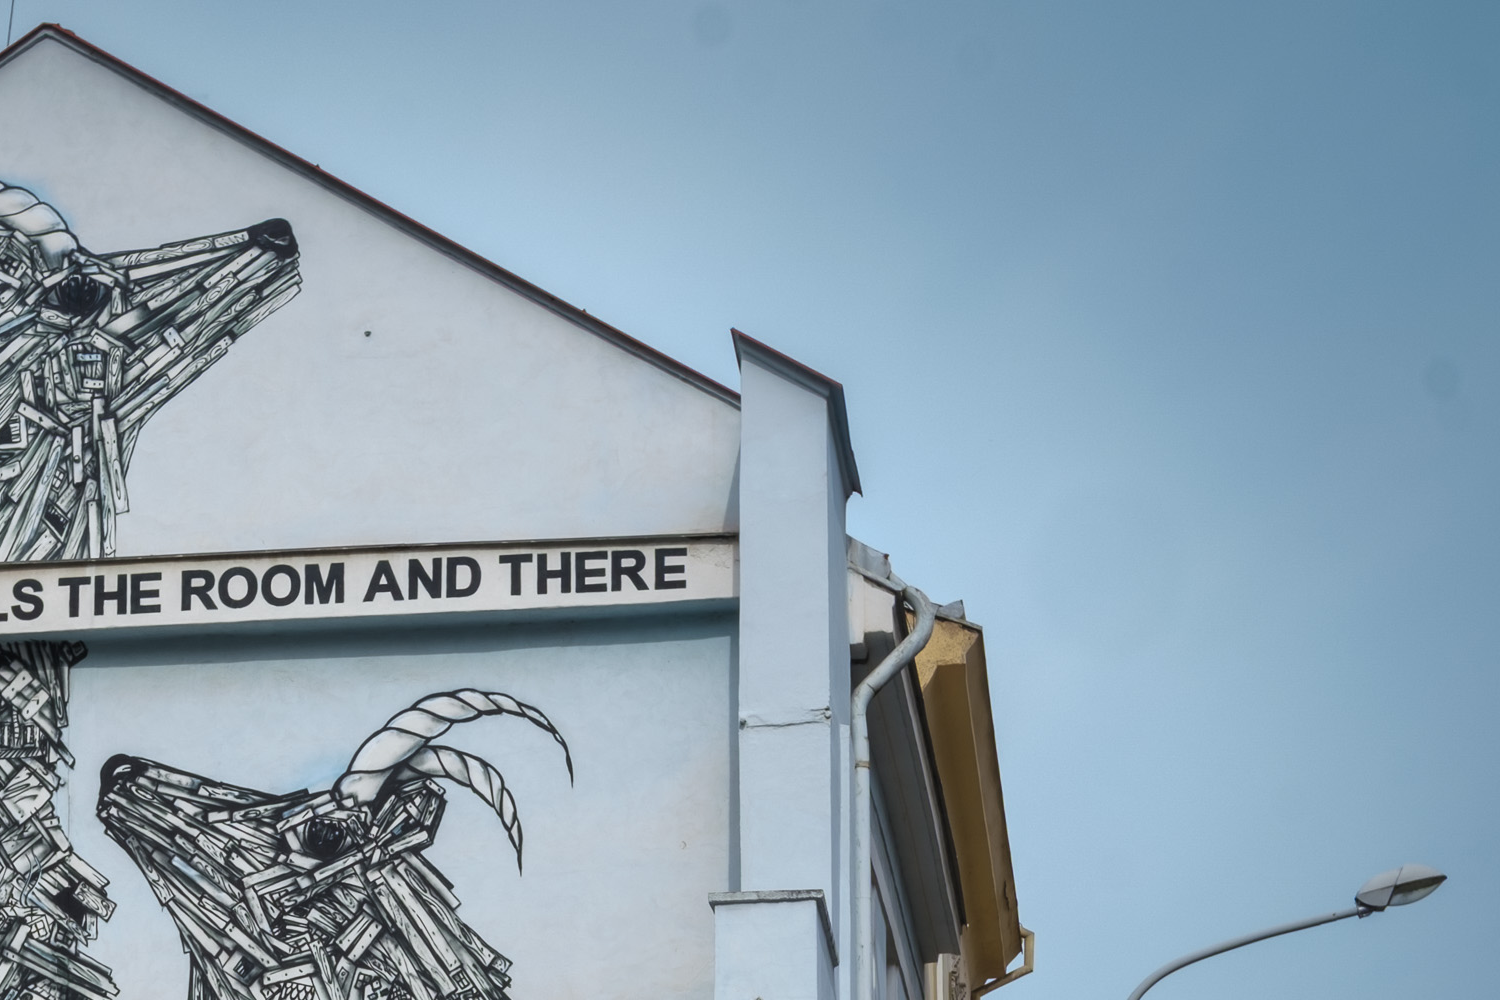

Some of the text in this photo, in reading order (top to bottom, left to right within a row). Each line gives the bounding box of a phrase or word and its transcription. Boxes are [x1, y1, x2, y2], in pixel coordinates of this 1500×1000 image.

[58, 571, 163, 618] THE
[180, 561, 345, 611] ROOM
[362, 555, 482, 602] AND
[498, 546, 688, 596] THERE
